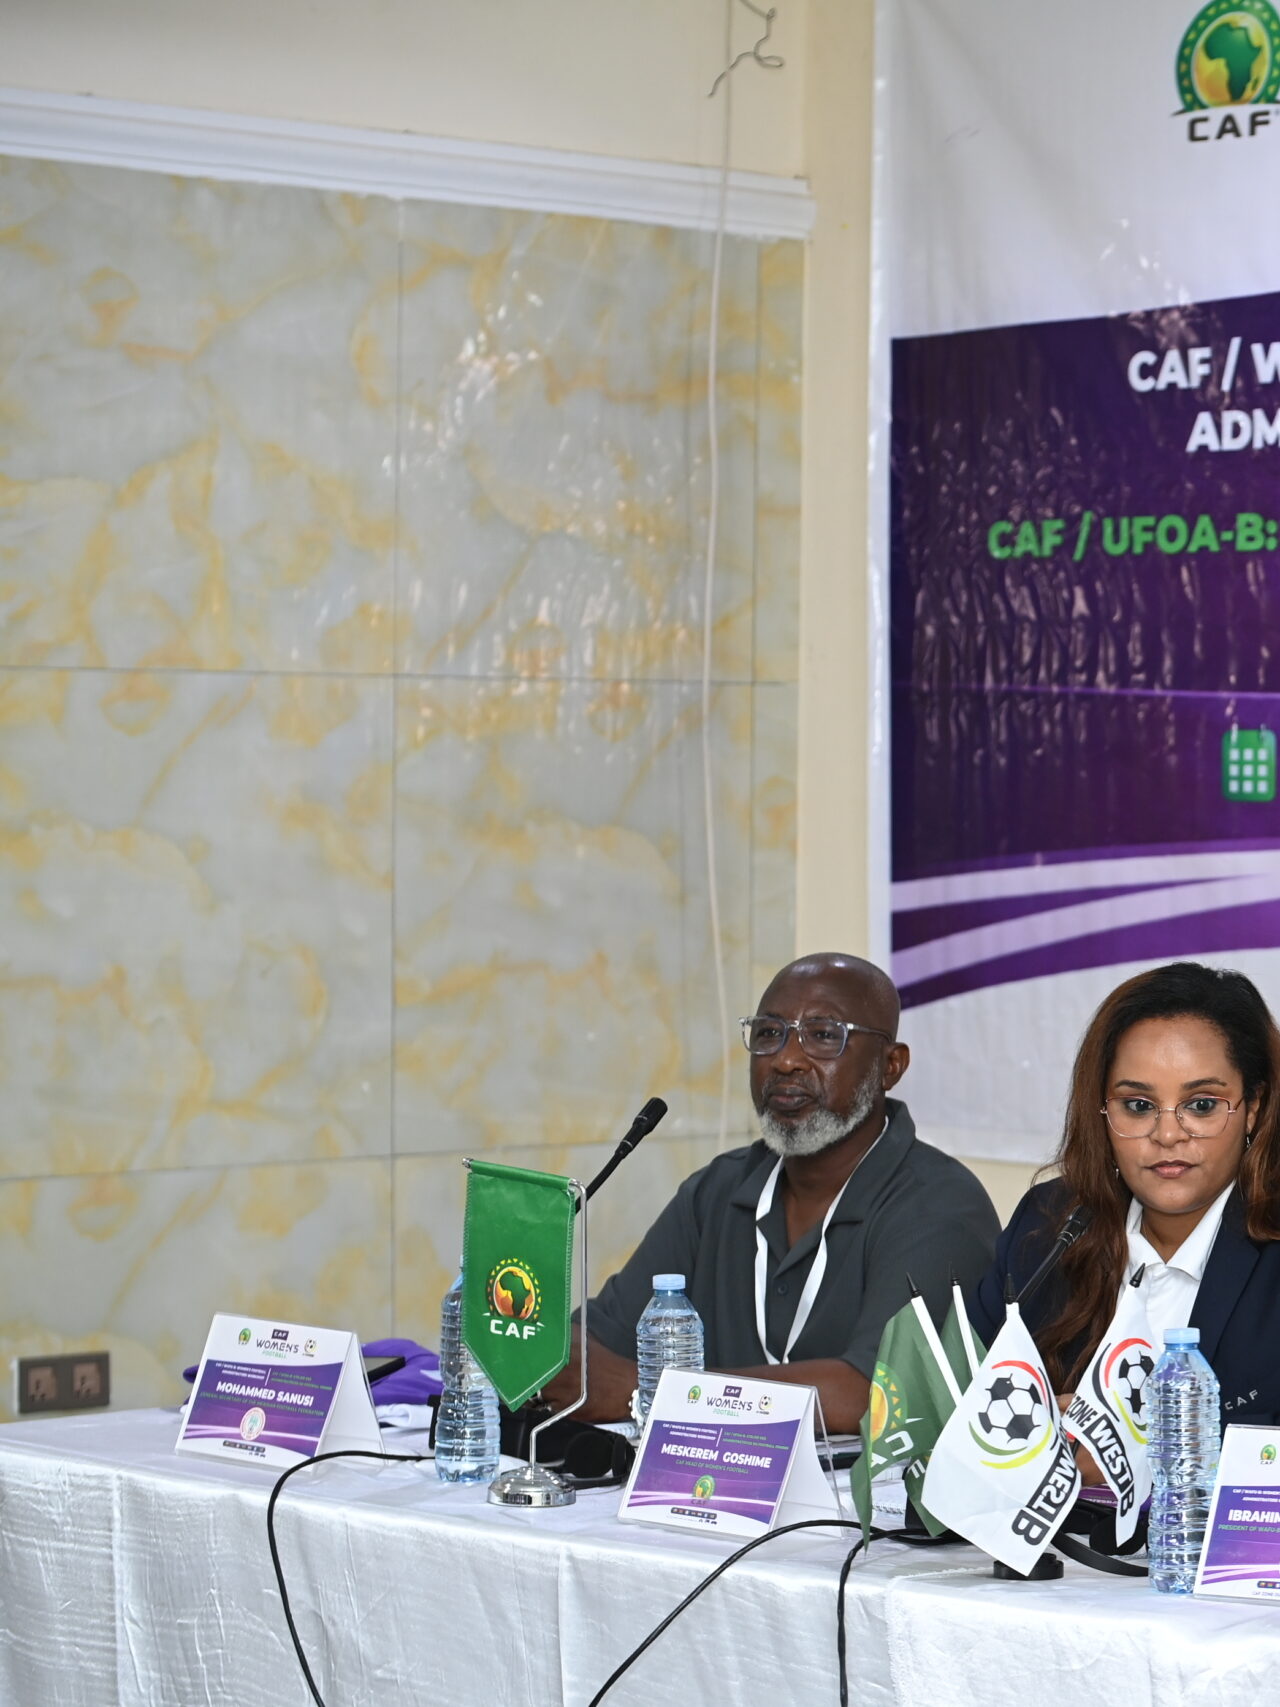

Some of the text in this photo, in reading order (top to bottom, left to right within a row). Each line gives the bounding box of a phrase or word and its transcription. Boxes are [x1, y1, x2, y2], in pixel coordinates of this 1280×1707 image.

[1187, 110, 1272, 142] CAF
[1127, 347, 1211, 394] CAF
[1221, 338, 1240, 391] /
[987, 519, 1064, 559] CAF
[1073, 511, 1093, 561] /
[1102, 512, 1277, 556] UFOA-B:
[490, 1320, 536, 1340] CAF
[216, 1381, 275, 1400] MOHAMMED
[277, 1391, 314, 1407] SANUSI
[706, 1396, 753, 1412] WOMEN'S
[1225, 1390, 1258, 1410] CAF
[661, 1443, 719, 1461] MESKEREM
[723, 1451, 772, 1468] GOSHIME
[1090, 1419, 1132, 1488] WEST
[1120, 1483, 1134, 1517] B
